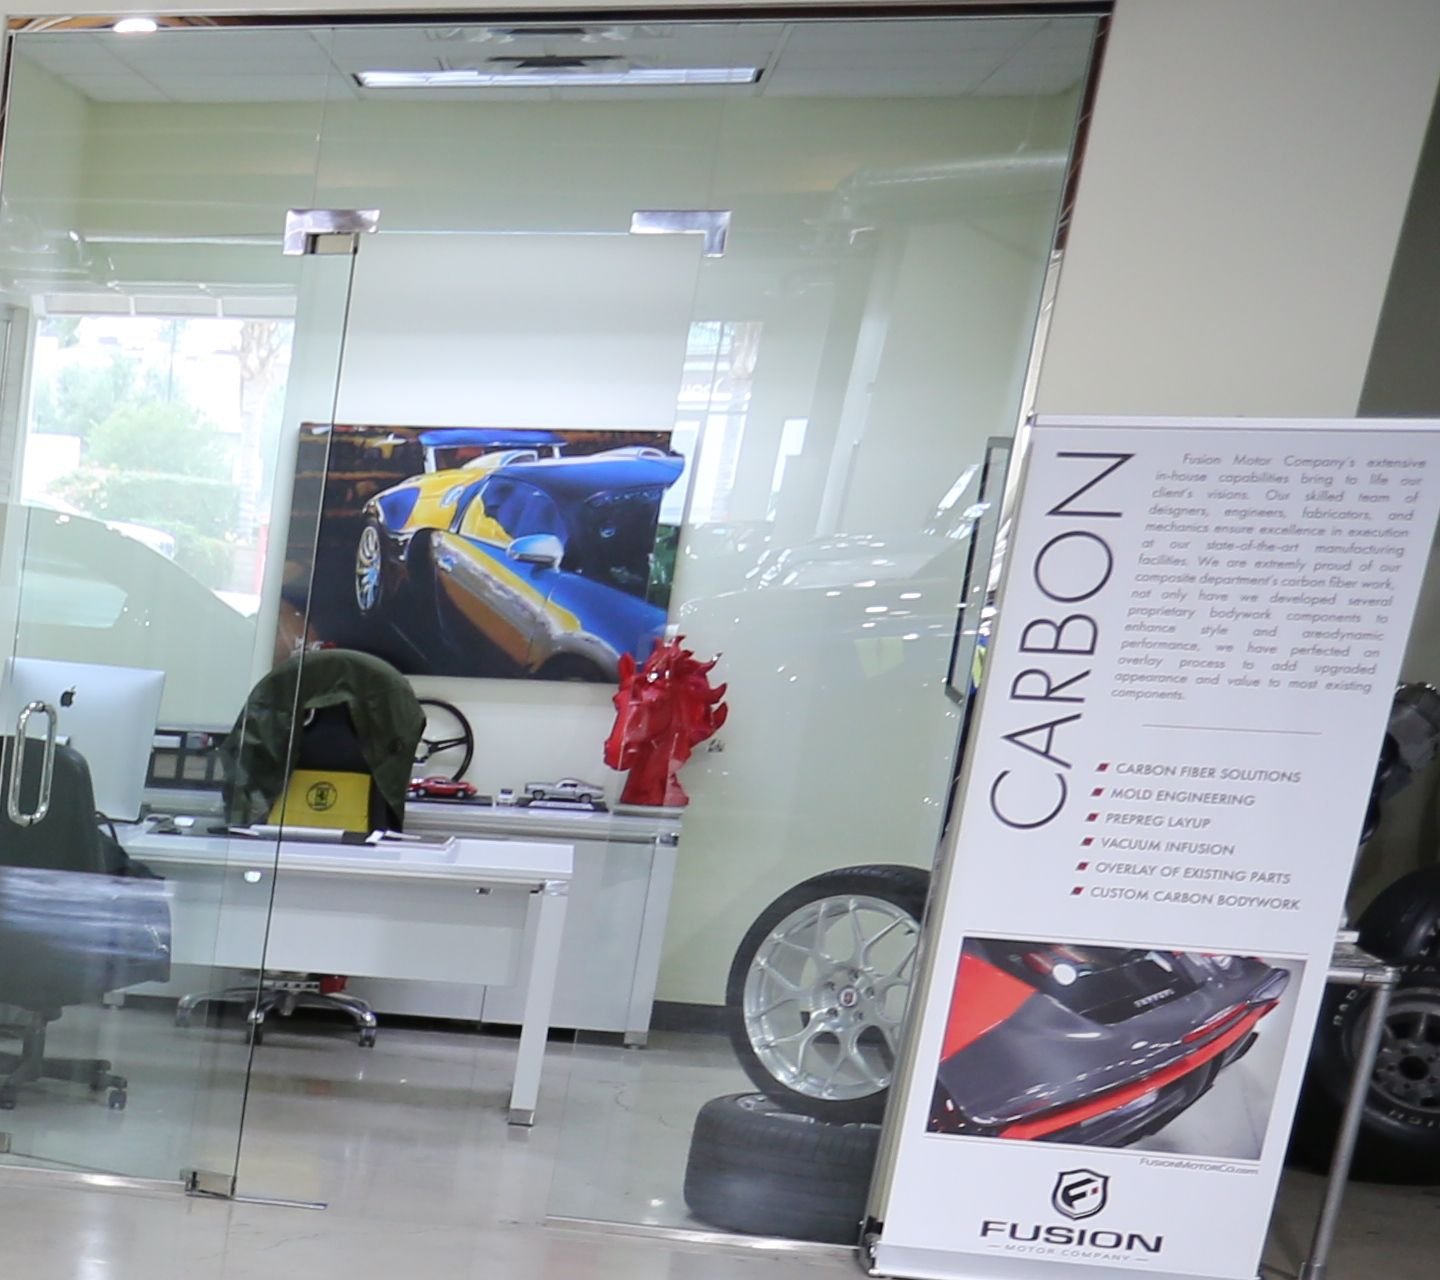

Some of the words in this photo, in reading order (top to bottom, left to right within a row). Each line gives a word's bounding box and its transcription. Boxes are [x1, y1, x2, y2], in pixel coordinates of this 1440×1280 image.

[989, 450, 1136, 830] CARBON
[1116, 763, 1176, 778] CARBON
[1181, 766, 1216, 780] FIBER
[1221, 768, 1301, 784] SOLUTIONS
[1111, 788, 1152, 802] MOLD
[1156, 790, 1255, 807] ENGINEERING
[1106, 813, 1163, 827] PREPREG
[1168, 816, 1210, 829] LAYUP
[1102, 838, 1160, 853] VACUUM
[1165, 841, 1234, 856] INFUSION
[1096, 863, 1155, 878] OVERLAY
[1160, 866, 1179, 879] OF
[1184, 867, 1246, 882] EXISTING
[1250, 871, 1290, 885] PARTS
[1091, 887, 1148, 902] CUSTOM
[1153, 891, 1213, 906] CARBON
[1217, 894, 1299, 911] BODYWORK
[979, 1220, 1164, 1253] FUSION
[1005, 1244, 1055, 1255] MOTOR
[1061, 1249, 1131, 1262] COMPANY
